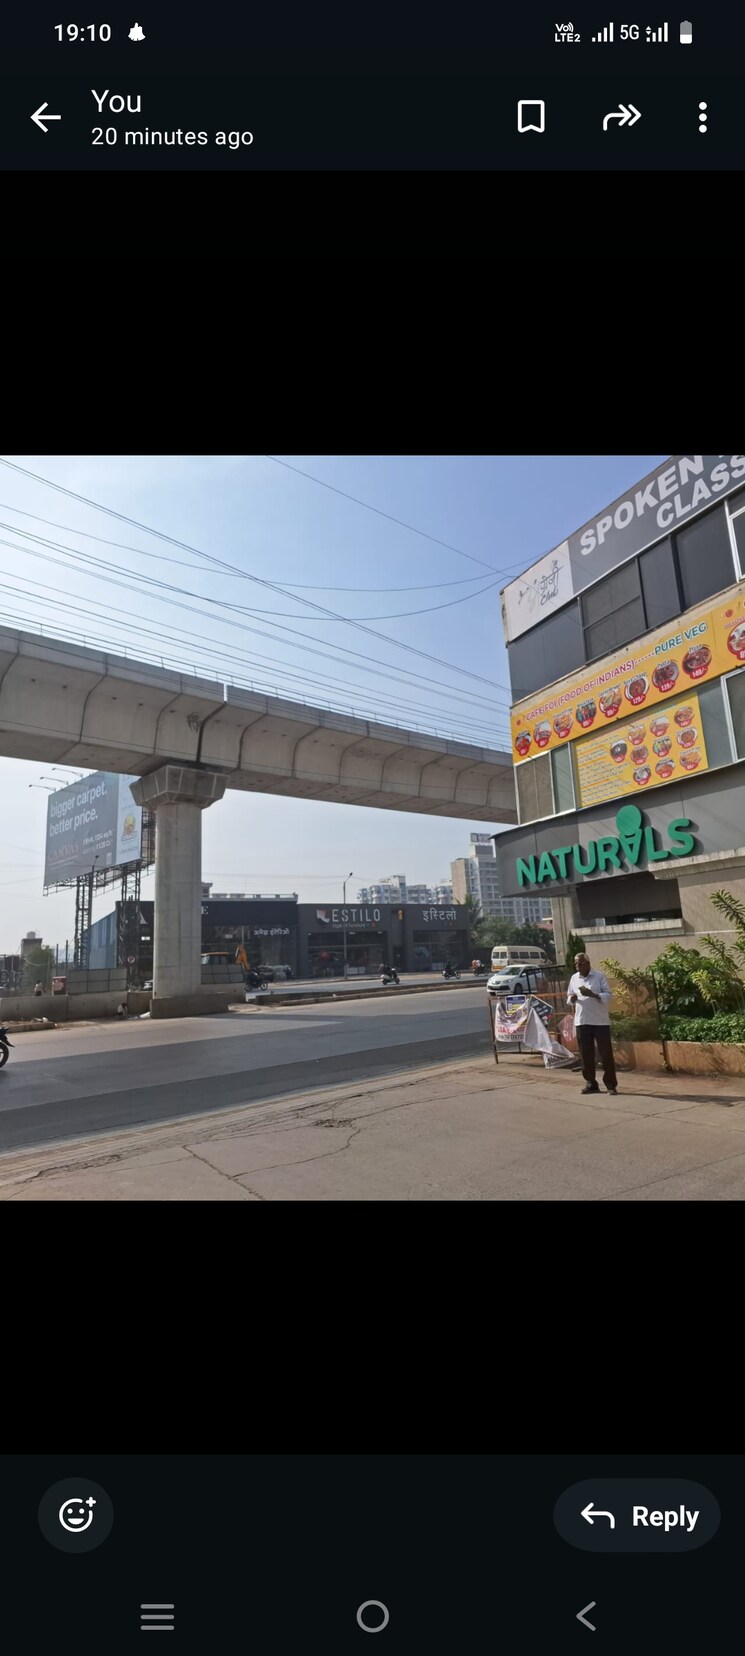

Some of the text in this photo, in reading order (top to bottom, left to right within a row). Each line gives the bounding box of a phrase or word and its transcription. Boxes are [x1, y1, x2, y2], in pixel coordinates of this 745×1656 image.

[580, 456, 705, 556] SPOKEN
[525, 707, 543, 721] CAFE
[584, 681, 595, 692] OF
[654, 635, 683, 655] PURE
[684, 622, 708, 640] VEG
[50, 796, 75, 818] bigger
[76, 781, 108, 806] carpet.
[49, 816, 74, 837] better
[74, 808, 98, 830] price.
[516, 812, 696, 888] NATURALS
[332, 908, 381, 922] ESTILO
[422, 907, 457, 922] इस्टिलो
